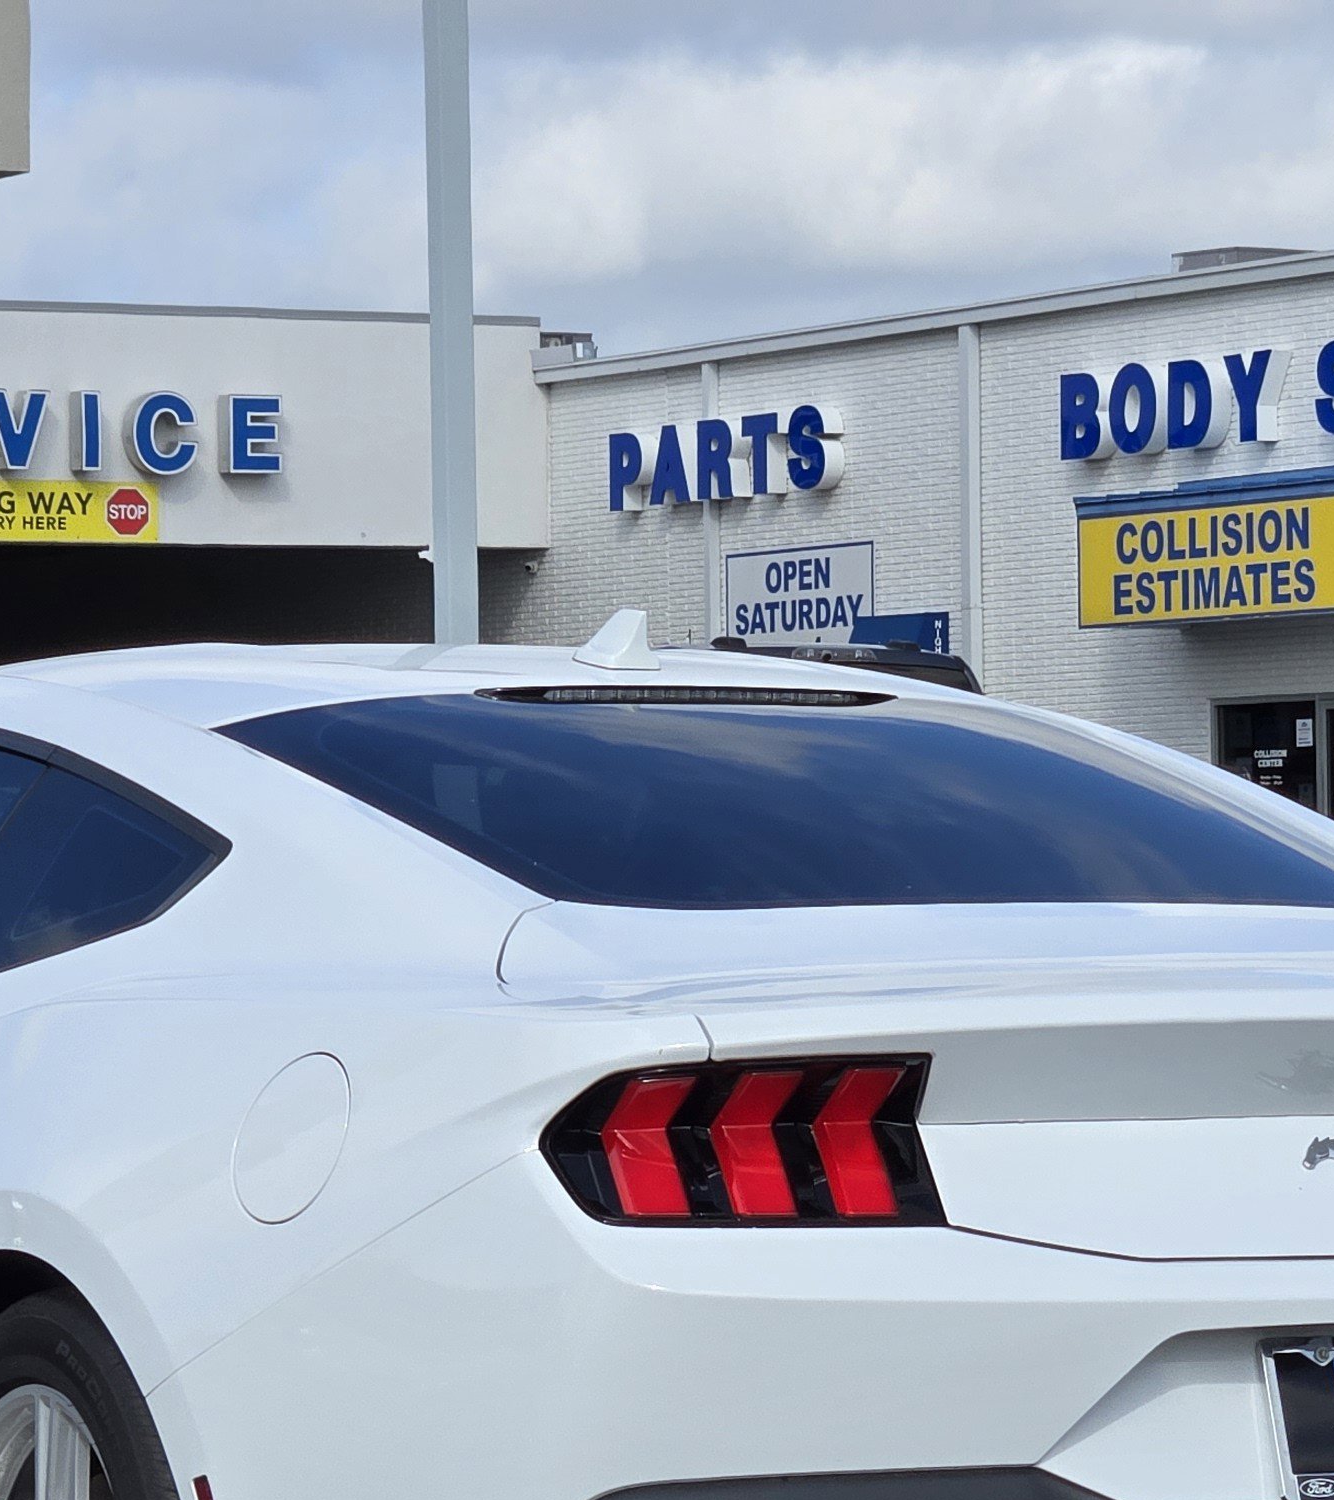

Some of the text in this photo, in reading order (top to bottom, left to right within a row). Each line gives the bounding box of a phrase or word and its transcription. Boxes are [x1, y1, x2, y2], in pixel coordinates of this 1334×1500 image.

[1060, 349, 1273, 461] BODY
[609, 404, 827, 511] PARTS
[22, 516, 67, 531] HERE
[28, 491, 94, 515] WAY
[108, 504, 147, 520] STOP
[1115, 506, 1310, 565] COLLISION
[765, 556, 831, 594] OPEN
[1113, 558, 1316, 616] ESTIMATES
[735, 593, 864, 636] SATURDAY
